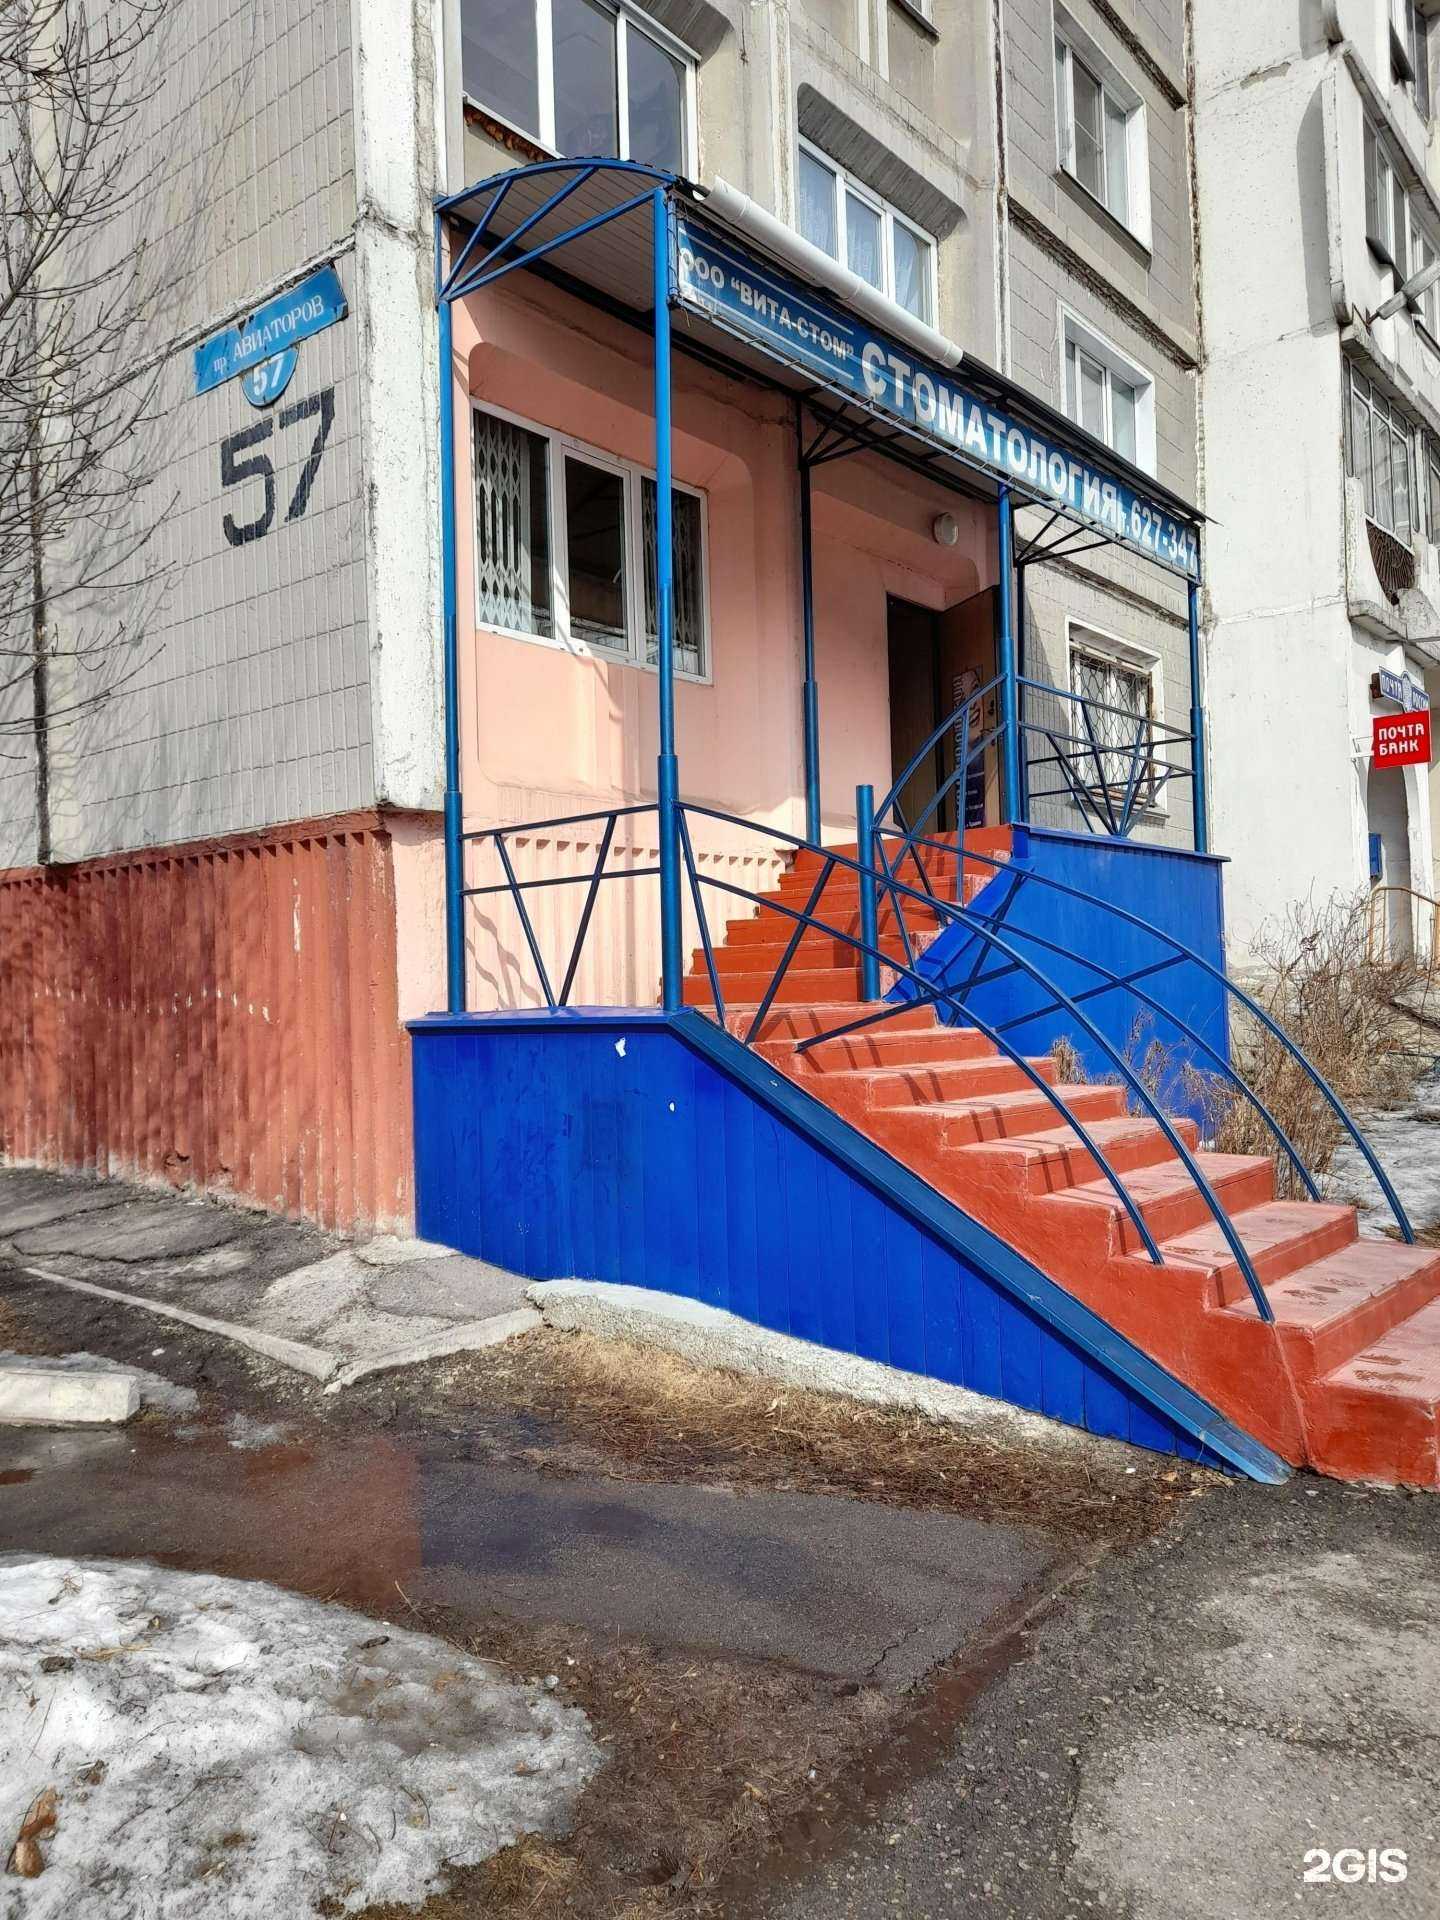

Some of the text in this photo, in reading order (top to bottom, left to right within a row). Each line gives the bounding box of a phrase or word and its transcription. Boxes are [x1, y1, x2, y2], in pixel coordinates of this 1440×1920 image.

[233, 295, 324, 362] АВИАТОРОВ
[253, 352, 285, 396] 57
[861, 342, 1117, 523] СТОМАТОЛОГИЯ
[221, 388, 335, 547] 57
[1378, 723, 1425, 741] ПОЧТА
[1379, 739, 1419, 756] БАНК
